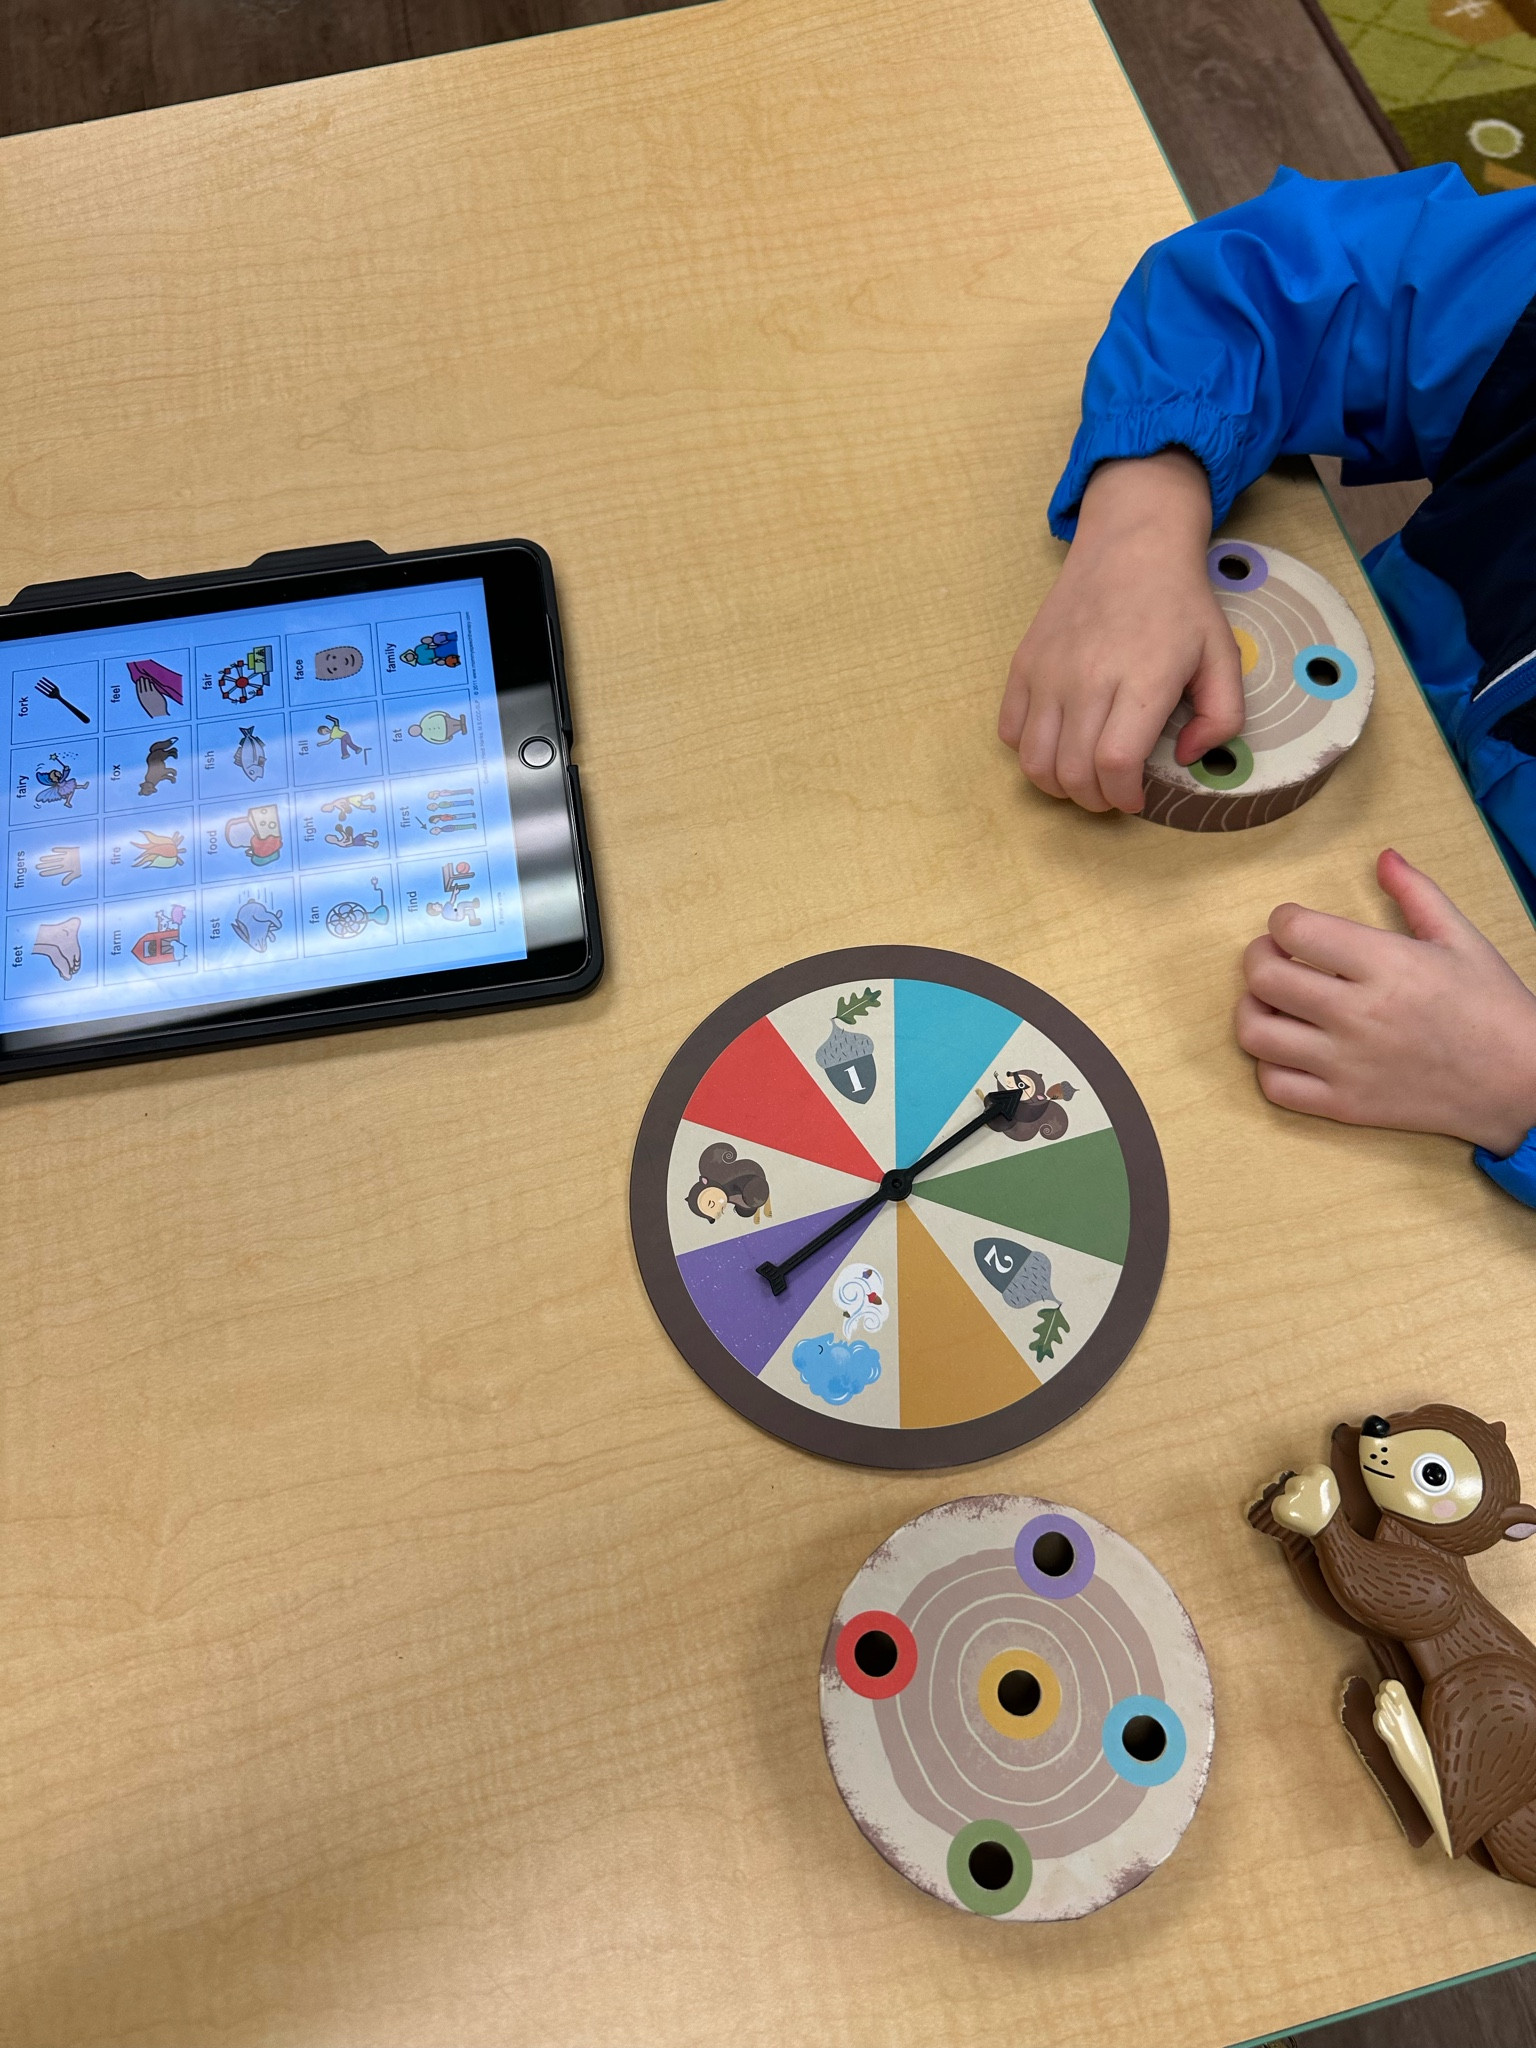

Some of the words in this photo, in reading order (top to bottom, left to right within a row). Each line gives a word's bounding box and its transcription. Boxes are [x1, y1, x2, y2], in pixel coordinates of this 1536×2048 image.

[386, 643, 397, 673] family
[293, 659, 305, 681] face
[201, 673, 213, 691] fair
[110, 684, 121, 704] feel
[17, 696, 29, 718] fork
[392, 728, 403, 744] fat
[298, 739, 310, 757] fall
[110, 763, 121, 781] fox
[204, 750, 215, 771] fish
[16, 775, 30, 799] fairy
[399, 806, 412, 829] first
[303, 816, 317, 843] fight
[206, 829, 218, 856] food
[110, 846, 121, 865] fire
[13, 850, 28, 890] fingers
[405, 889, 419, 913] find
[308, 905, 320, 925] fan
[209, 917, 221, 941] fast
[108, 929, 122, 957] farm
[11, 945, 23, 968] feet
[843, 1065, 866, 1093] 1
[983, 1244, 1014, 1274] 2
